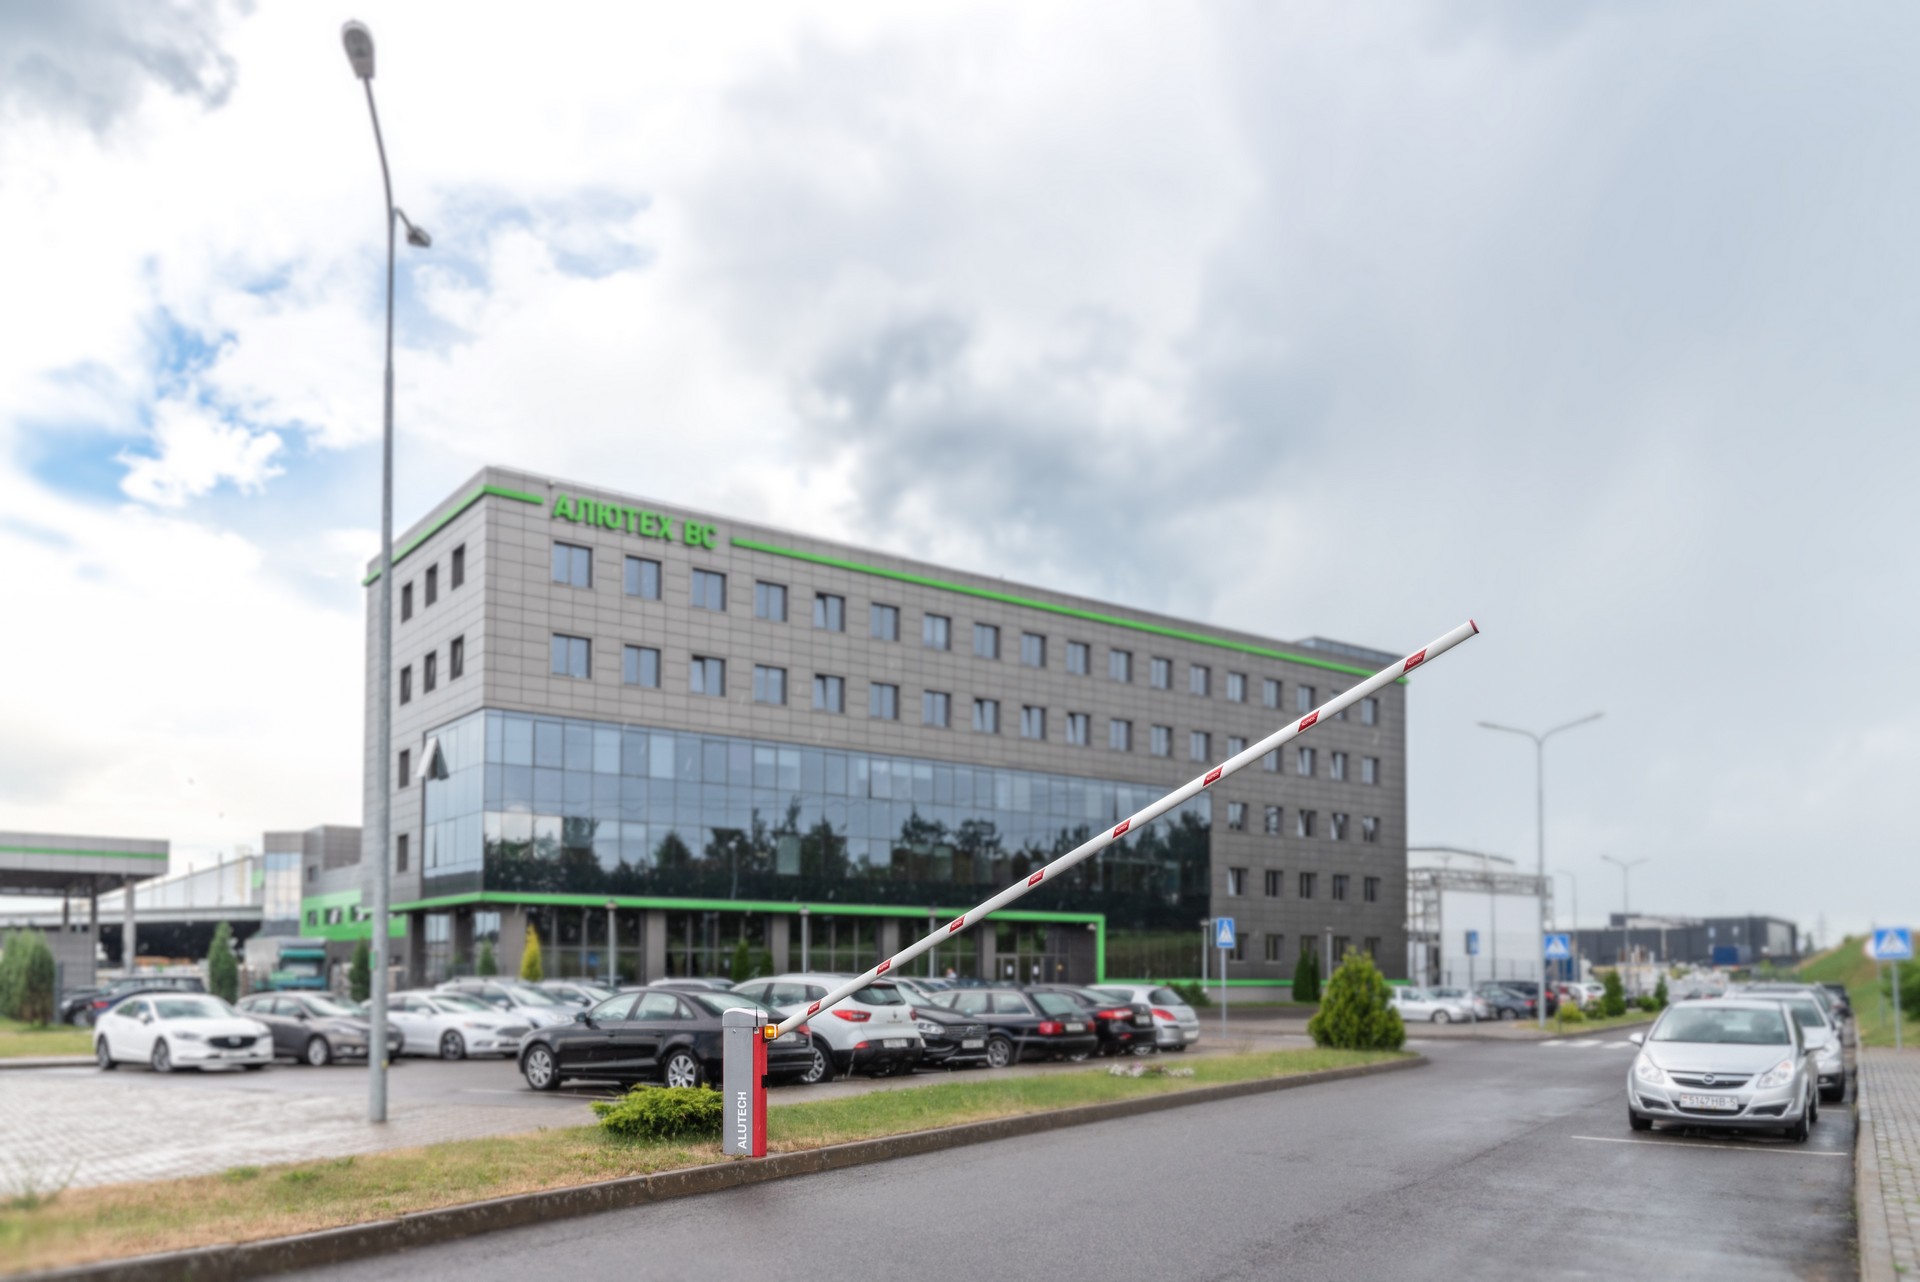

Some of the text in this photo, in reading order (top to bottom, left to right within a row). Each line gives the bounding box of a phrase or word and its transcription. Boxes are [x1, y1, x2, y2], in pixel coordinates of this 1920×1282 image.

[553, 494, 717, 549] АЛЮТЕХ ВС
[737, 1091, 747, 1150] ALUTECH
